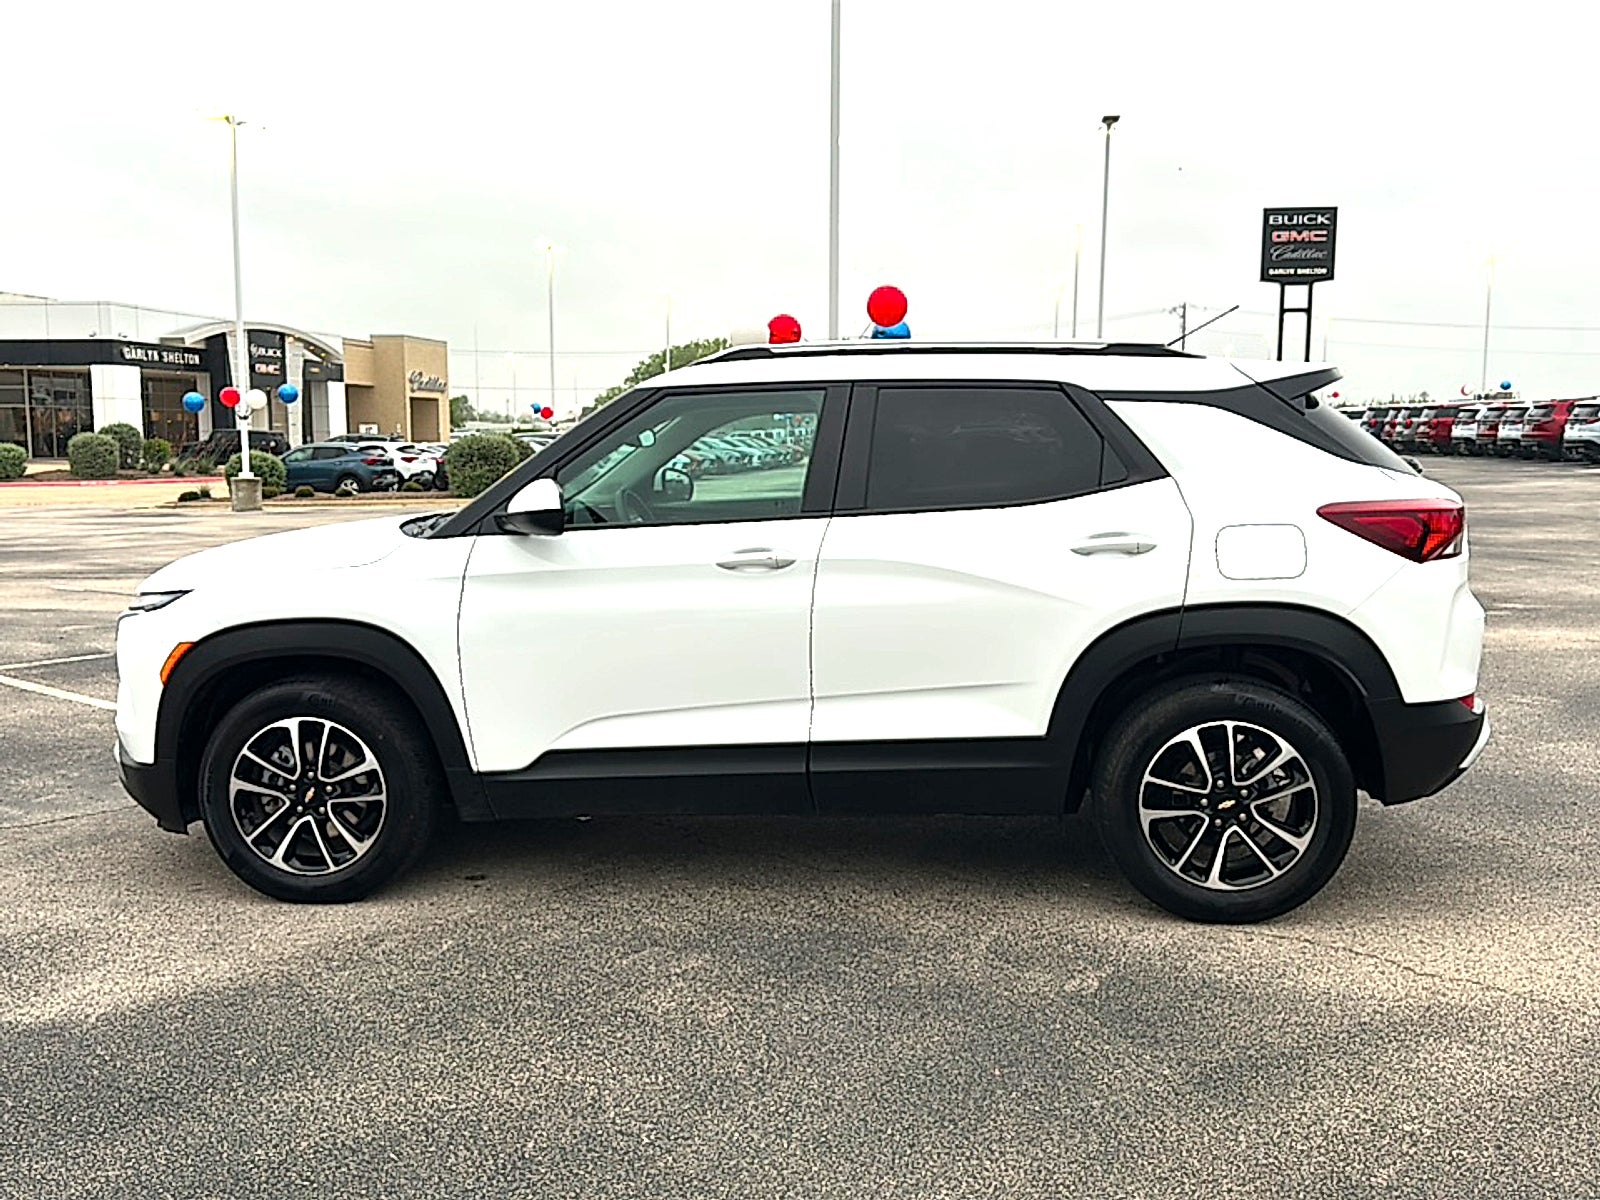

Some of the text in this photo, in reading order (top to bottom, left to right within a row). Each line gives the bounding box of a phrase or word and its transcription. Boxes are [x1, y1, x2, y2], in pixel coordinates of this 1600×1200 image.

[1268, 214, 1331, 225] BUICK
[1271, 230, 1328, 242] GMC
[161, 351, 200, 365] SHELTON
